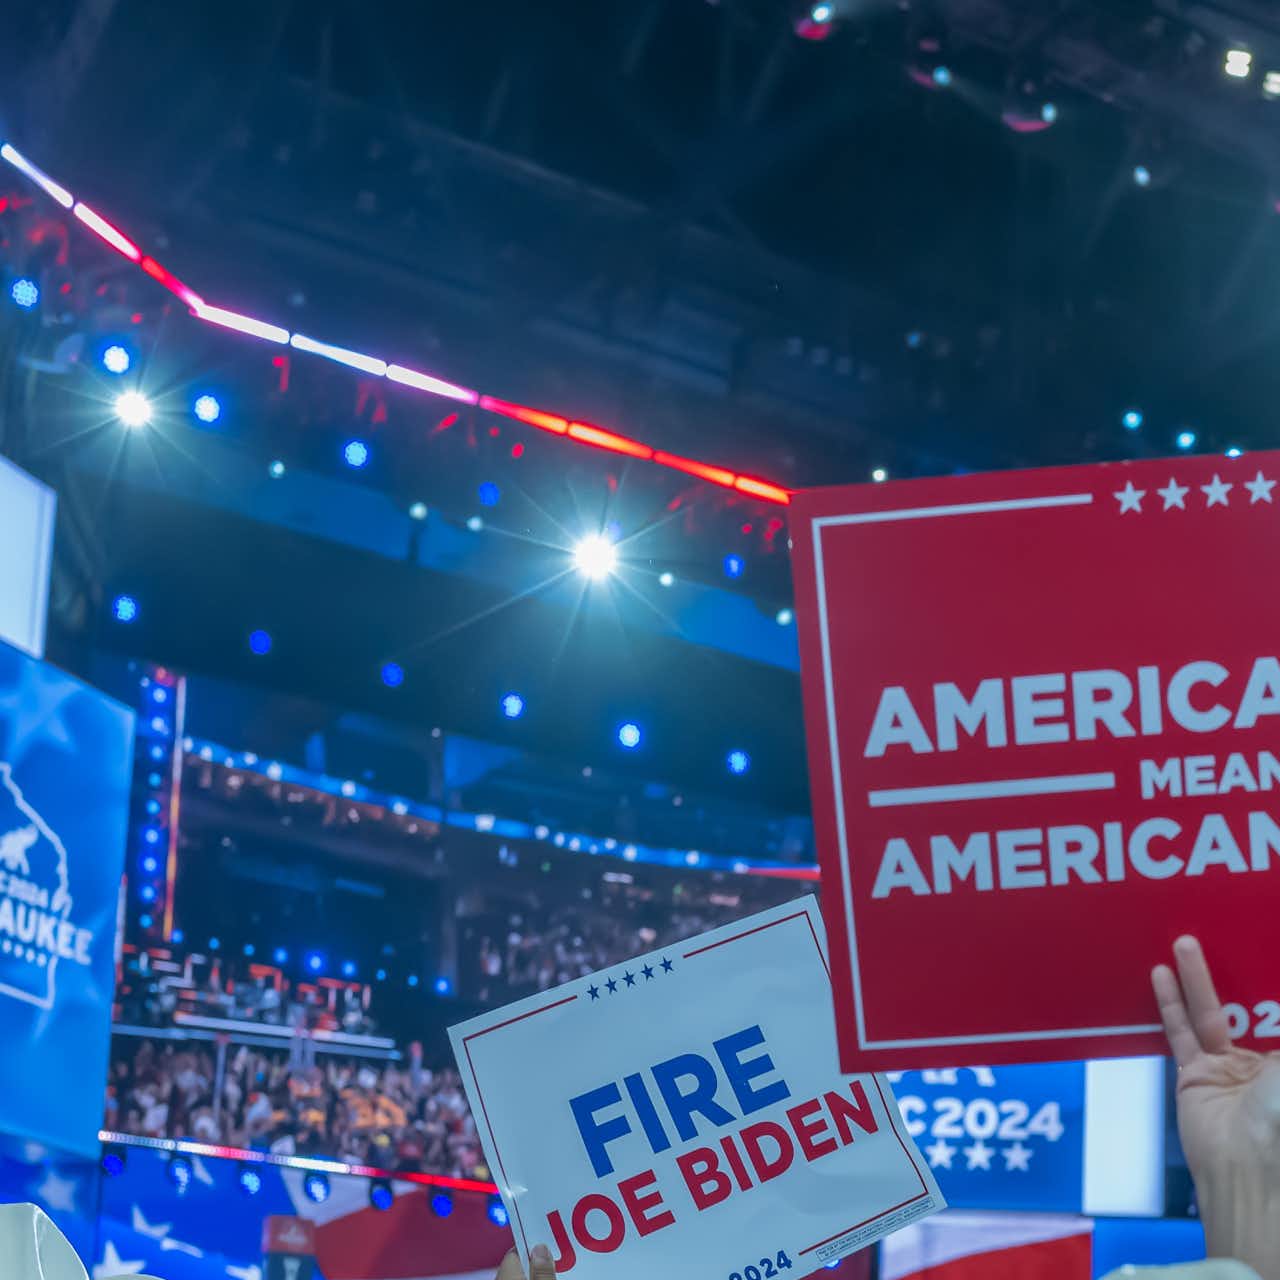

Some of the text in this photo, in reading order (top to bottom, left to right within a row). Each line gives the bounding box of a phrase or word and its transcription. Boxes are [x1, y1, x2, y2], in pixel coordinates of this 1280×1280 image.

[546, 1168, 677, 1274] JOE
[676, 1079, 880, 1213] BIDEN
[569, 1024, 792, 1180] FIRE
